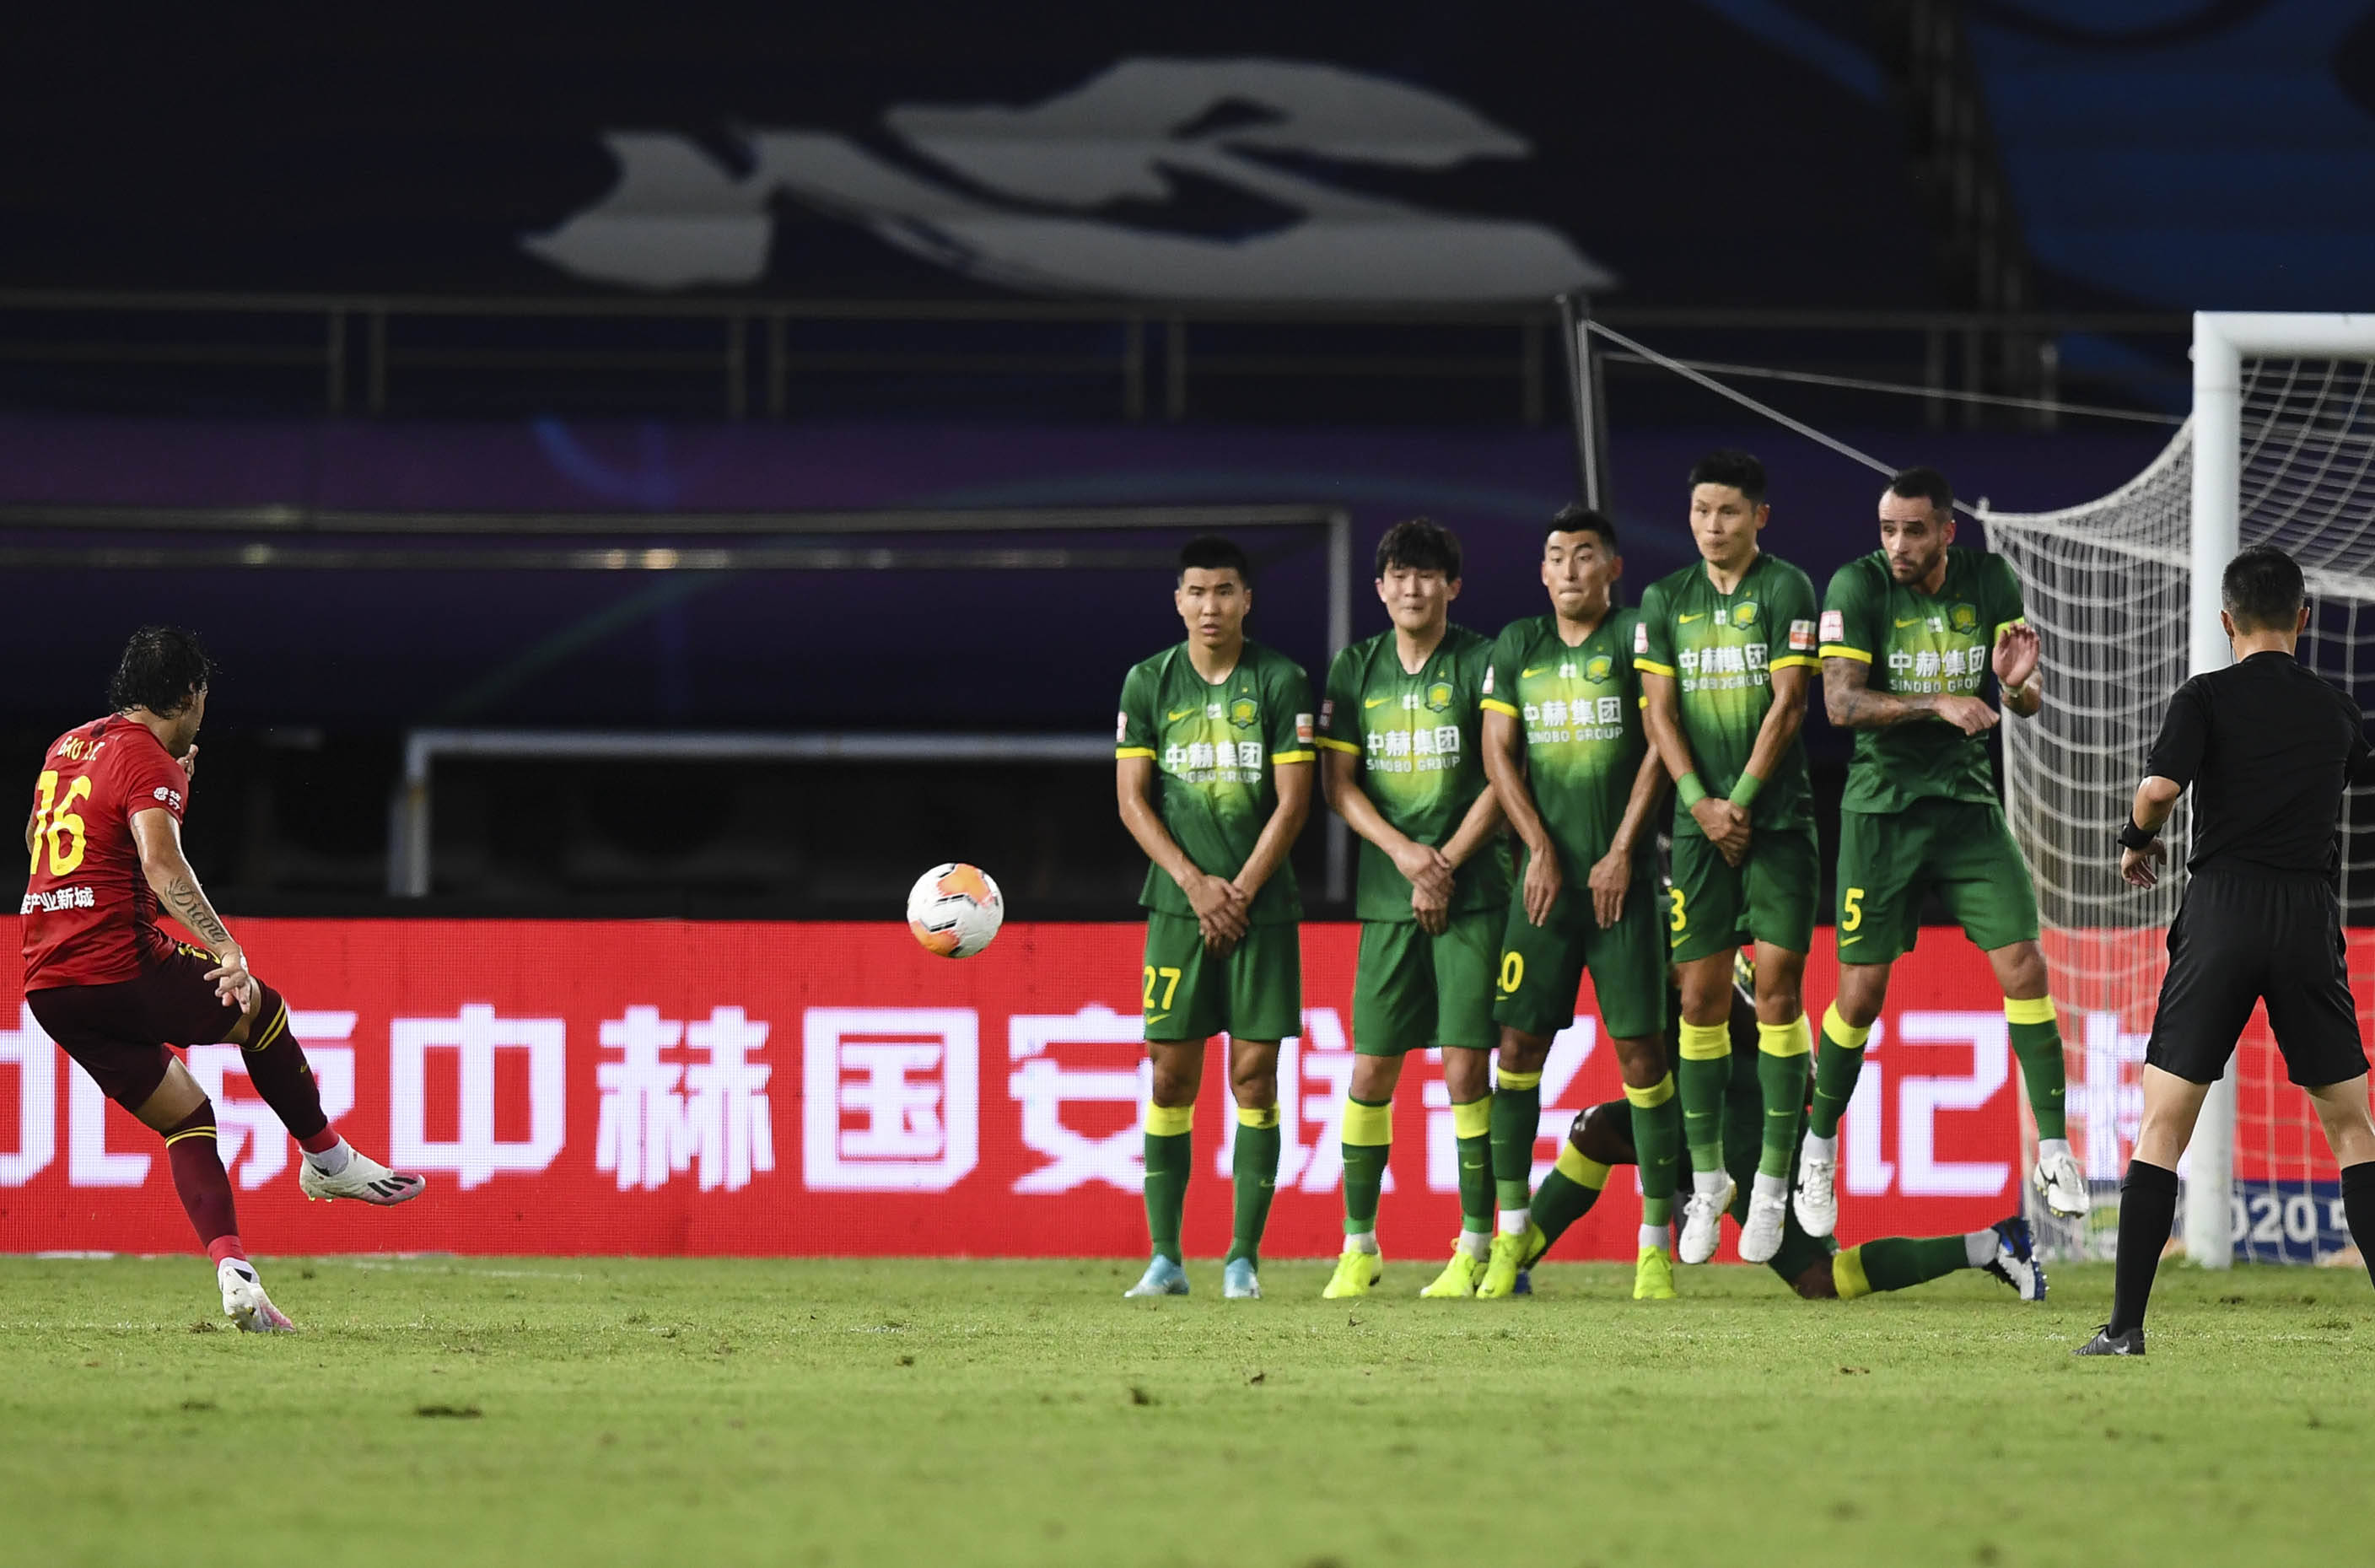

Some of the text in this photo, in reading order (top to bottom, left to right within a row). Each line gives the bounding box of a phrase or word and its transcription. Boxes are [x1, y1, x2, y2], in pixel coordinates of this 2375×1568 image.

[1677, 643, 1768, 675] 中赫集团
[1888, 644, 1985, 677] 中赫集团
[1889, 679, 1941, 692] SINOBO
[1523, 696, 1621, 729] 中赫集团
[1366, 725, 1459, 755] 中赫集团
[1575, 726, 1623, 741] GROUP
[1166, 741, 1263, 770] 中赫集团
[1418, 756, 1460, 771] GROUP
[30, 770, 92, 876] 16
[1842, 888, 1865, 931] 5
[1144, 965, 1182, 1010] 27
